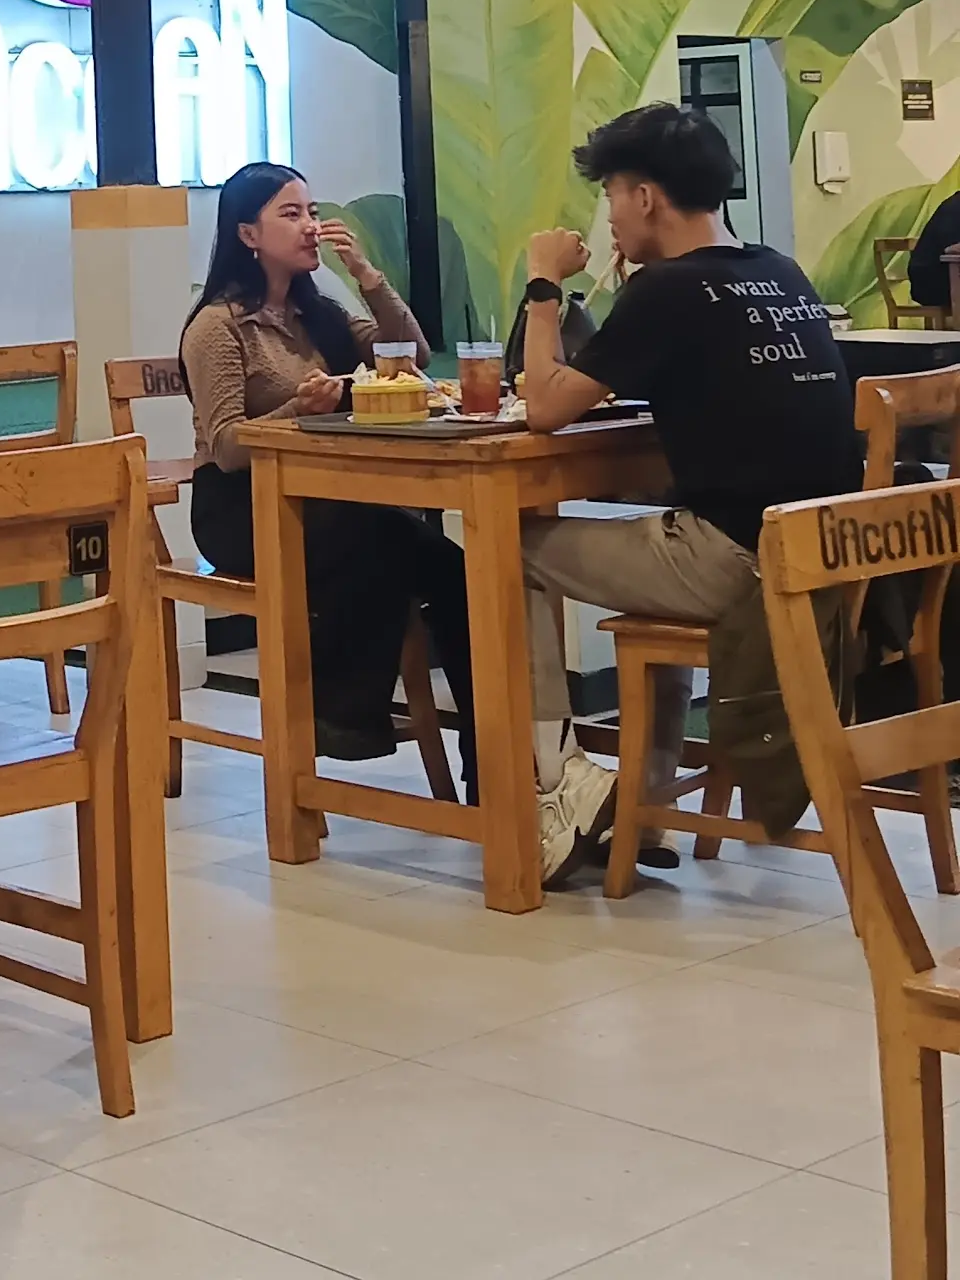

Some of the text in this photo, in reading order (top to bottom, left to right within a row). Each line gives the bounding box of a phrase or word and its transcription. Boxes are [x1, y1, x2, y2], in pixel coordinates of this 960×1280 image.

[702, 280, 785, 302] i want
[746, 306, 763, 324] a
[749, 332, 807, 364] soul
[141, 363, 182, 394] GAC
[76, 535, 102, 561] 10
